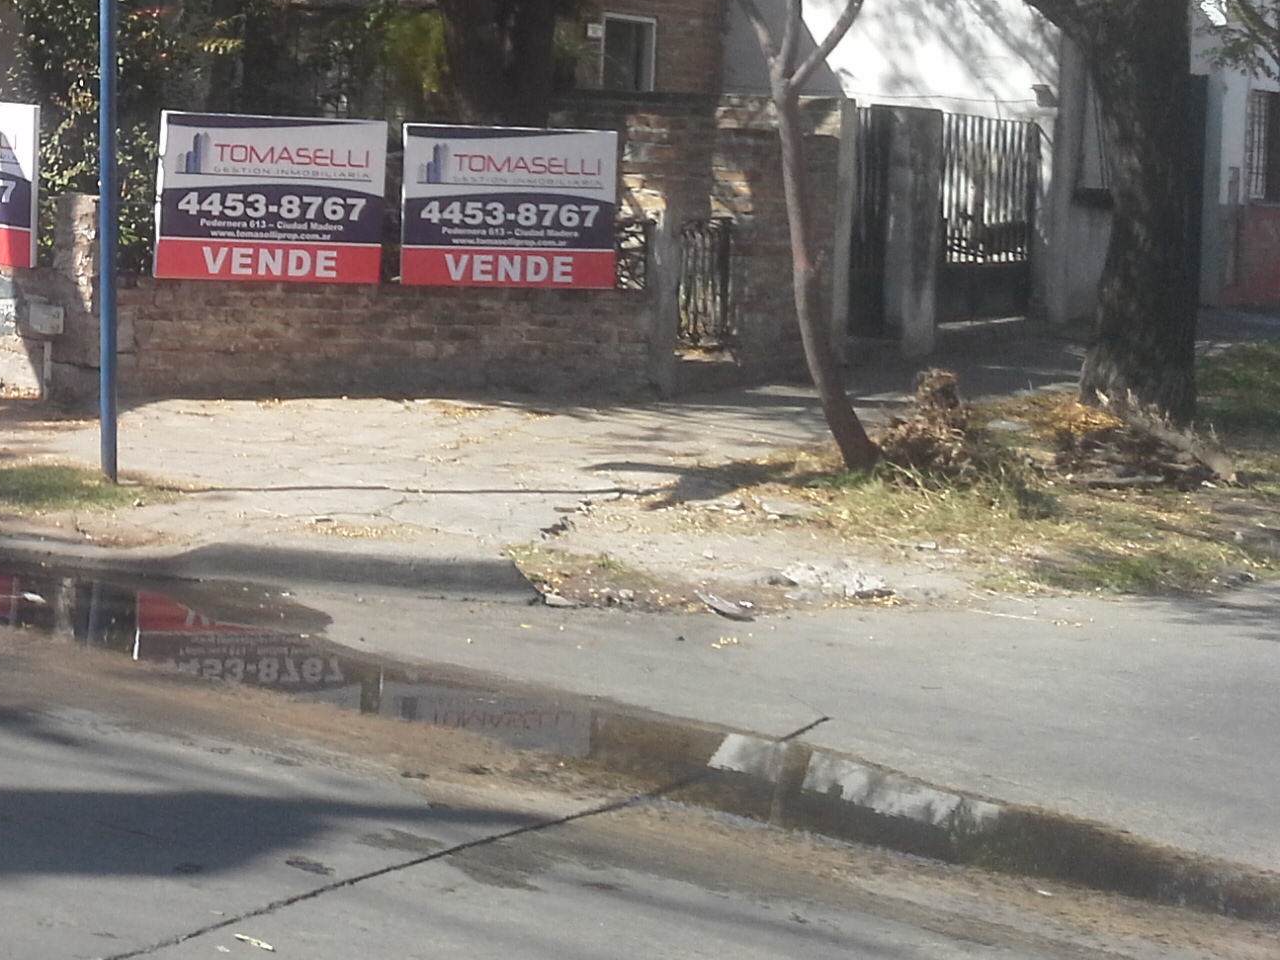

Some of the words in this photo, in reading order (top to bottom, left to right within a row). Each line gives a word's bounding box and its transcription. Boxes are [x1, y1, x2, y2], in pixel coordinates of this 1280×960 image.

[214, 143, 370, 169] TOMASELLI
[453, 153, 601, 176] TOMASELLI
[178, 192, 366, 221] 4453-8767
[420, 200, 600, 227] 4453-8767
[200, 218, 247, 228] Pedernera
[249, 220, 266, 228] 613
[276, 221, 308, 230] Ciudad
[310, 222, 343, 231] Madero
[514, 228, 544, 237] Ciudad
[202, 246, 338, 277] VENDE
[444, 253, 573, 283] VENDE
